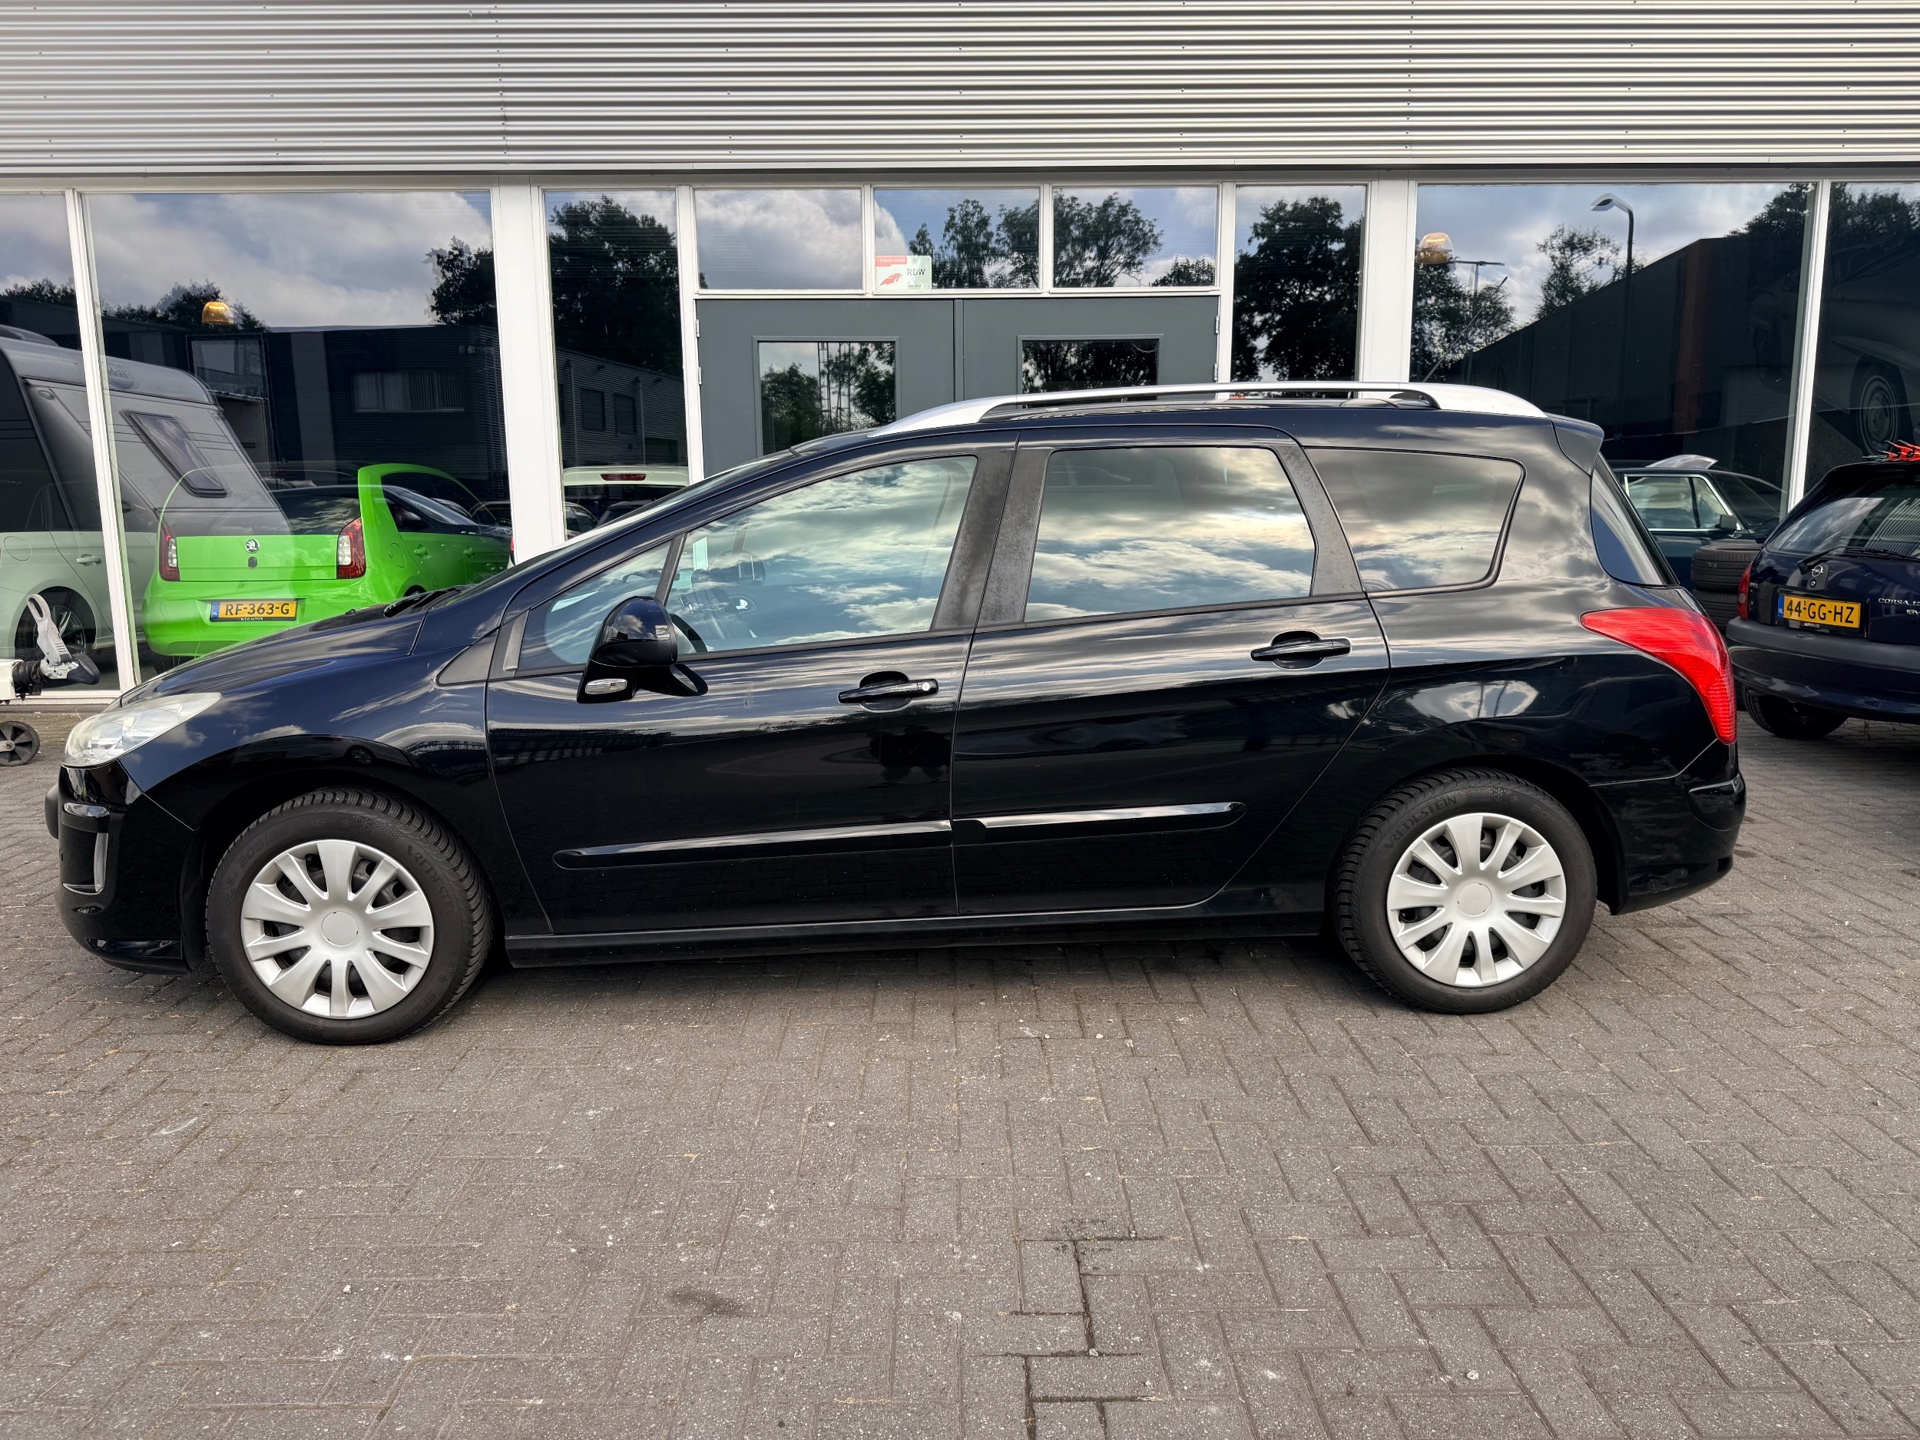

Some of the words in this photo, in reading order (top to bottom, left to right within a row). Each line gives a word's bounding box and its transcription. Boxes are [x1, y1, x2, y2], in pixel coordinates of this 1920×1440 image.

[225, 602, 290, 616] RF-363-G
[1786, 599, 1855, 624] 44-GG-HZ
[1878, 598, 1910, 607] CORSA
[1381, 795, 1457, 849] VREDESTEIN
